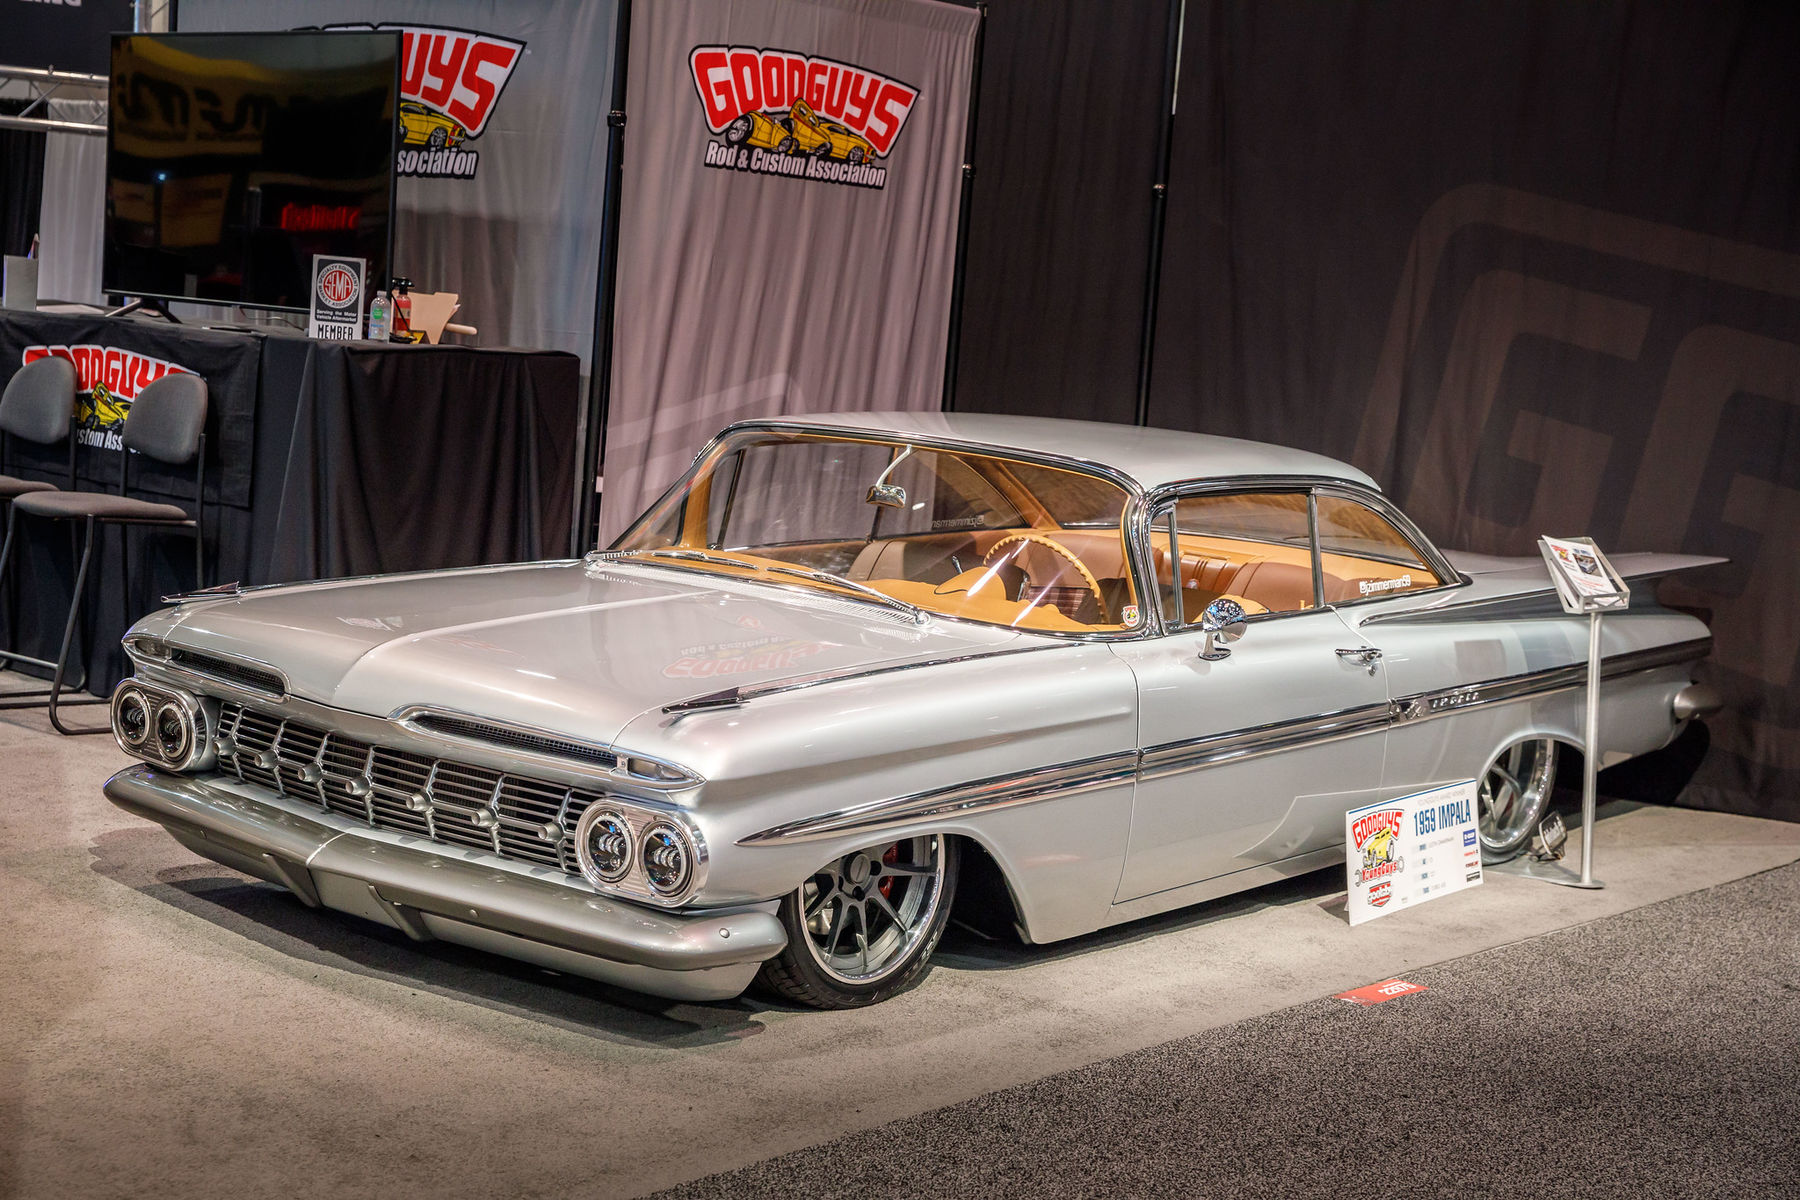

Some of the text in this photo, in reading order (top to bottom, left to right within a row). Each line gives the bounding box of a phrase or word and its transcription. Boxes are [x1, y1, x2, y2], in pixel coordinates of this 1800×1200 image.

[694, 52, 914, 153] GOODGUYS
[397, 147, 478, 175] sociation
[705, 142, 886, 187] Rod & Custom Association
[324, 271, 352, 300] SEMA
[318, 324, 353, 340] MEMBER
[1352, 811, 1403, 849] GOODGUYS
[1414, 798, 1472, 836] 1959 IMPALA
